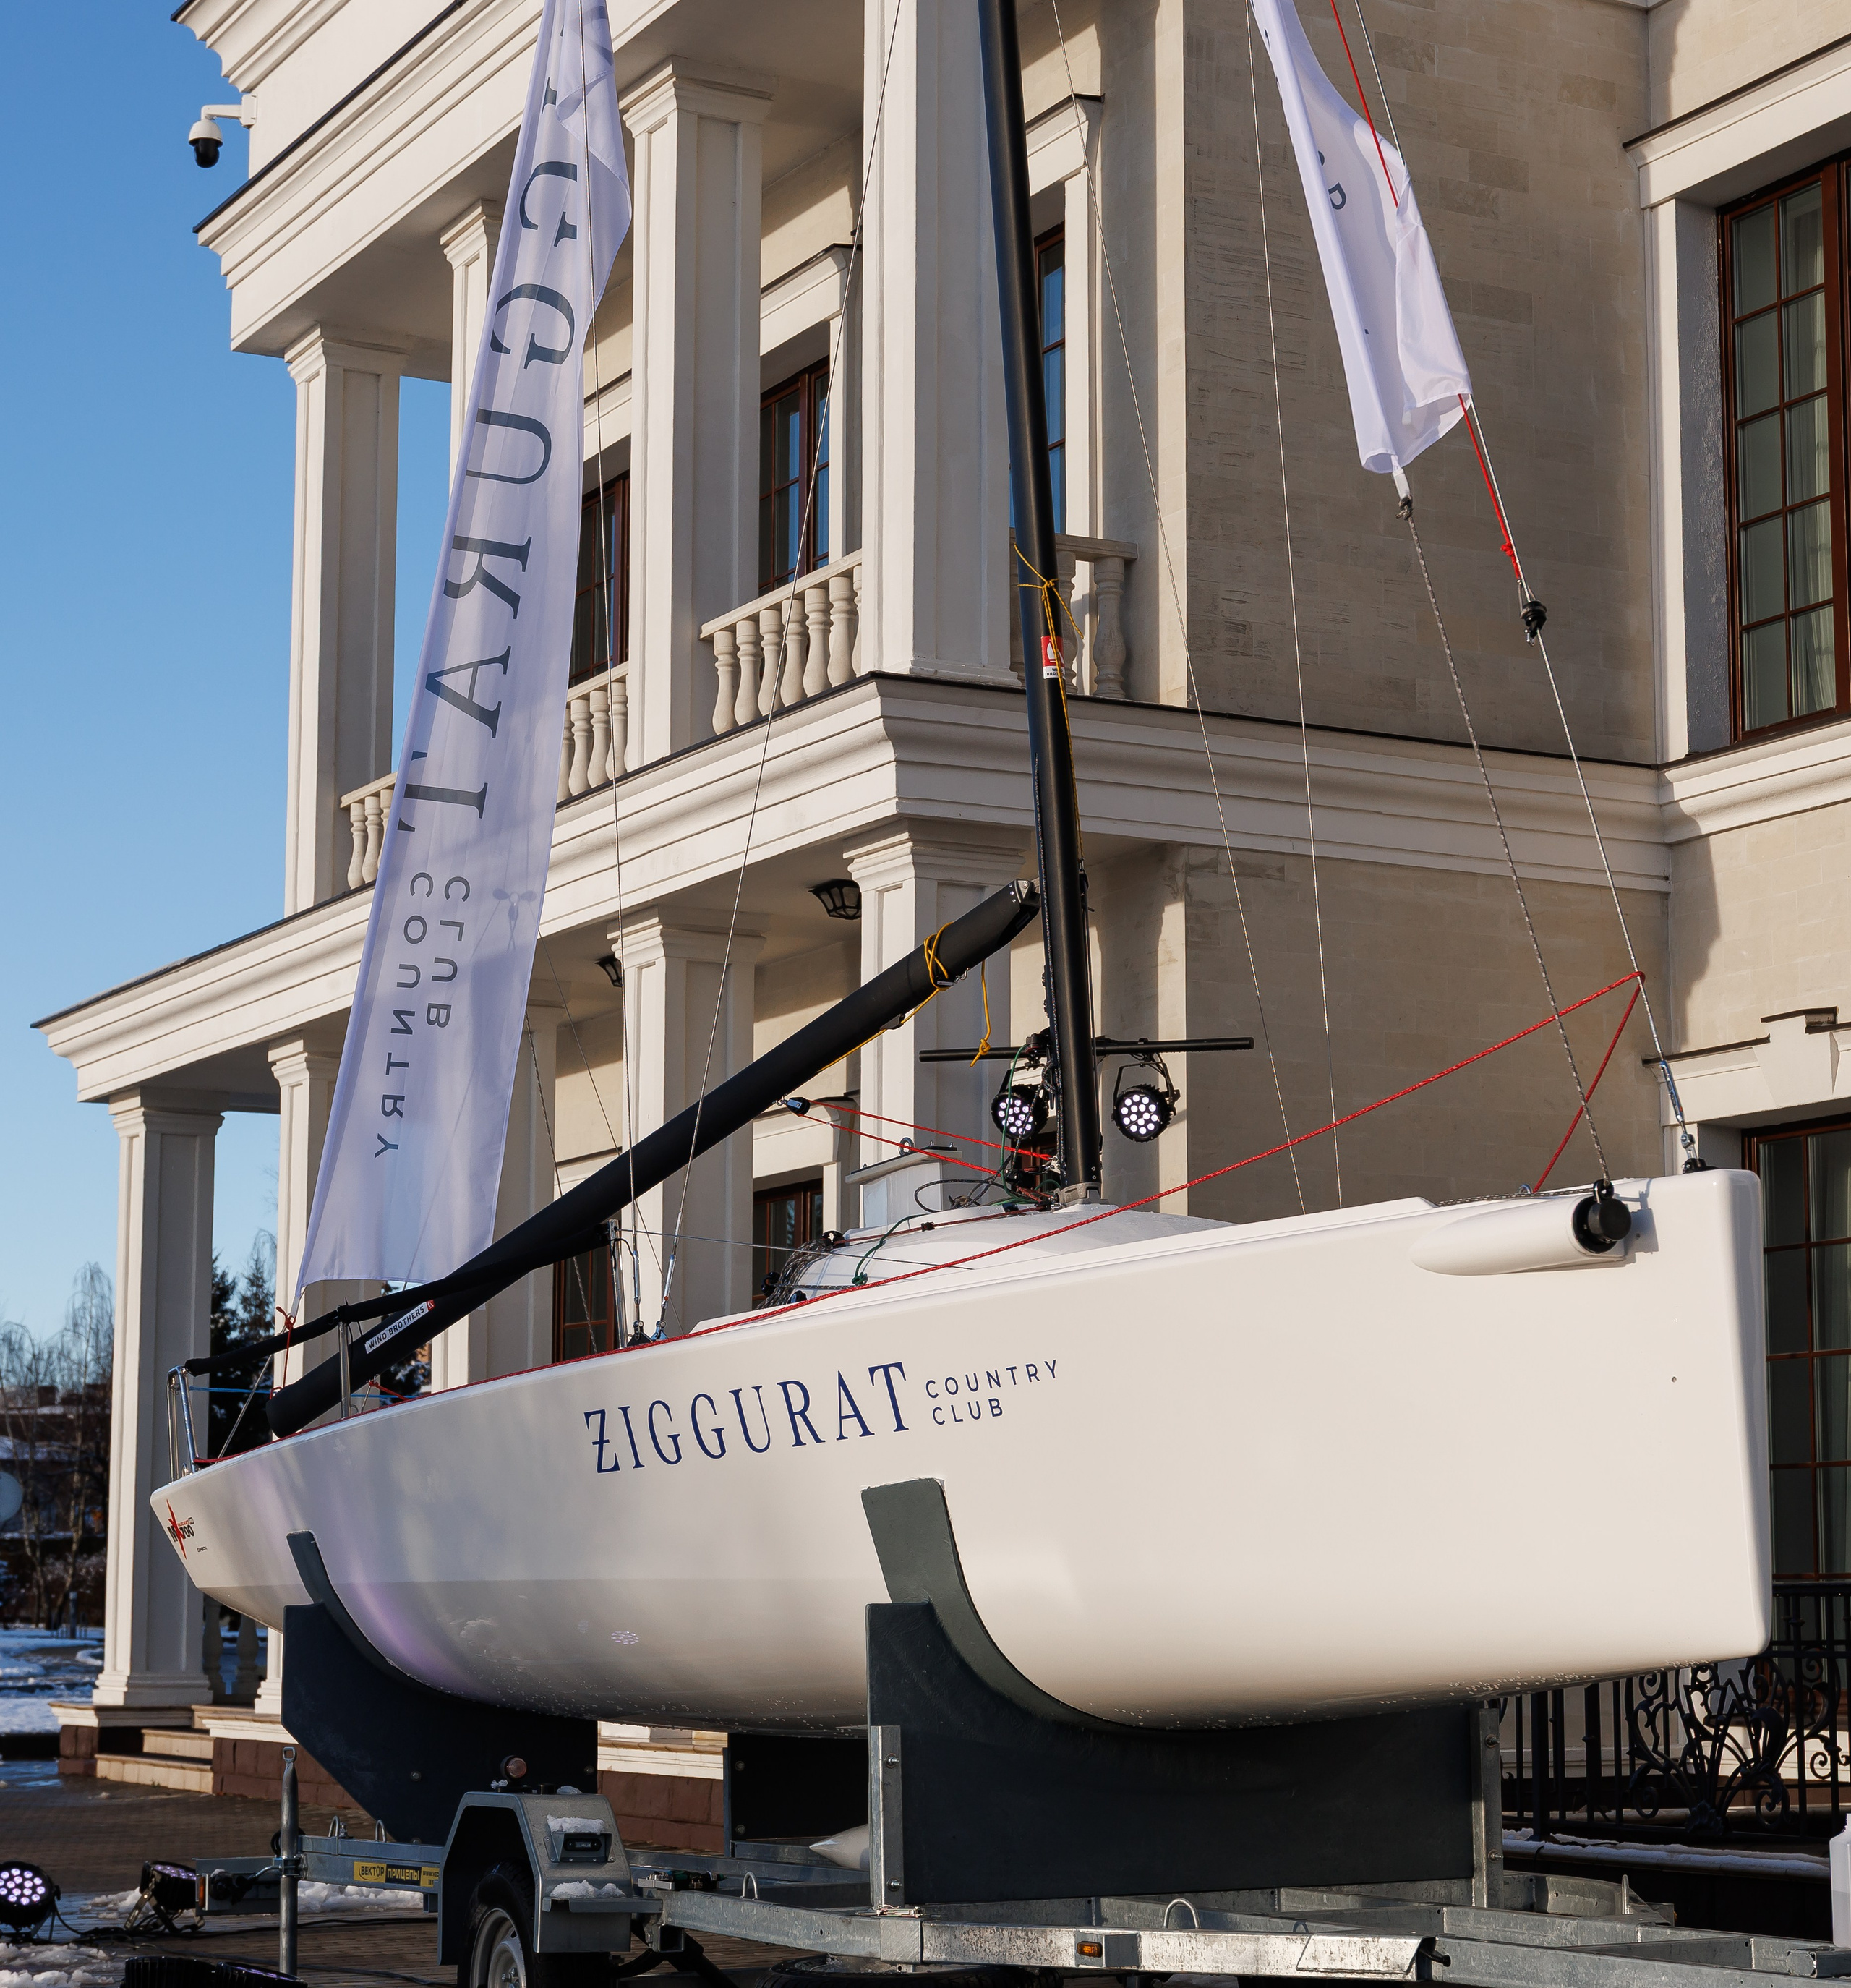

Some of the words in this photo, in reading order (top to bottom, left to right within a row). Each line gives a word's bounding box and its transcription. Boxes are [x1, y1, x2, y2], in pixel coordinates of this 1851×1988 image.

[367, 1332, 387, 1349] WIND
[388, 1305, 424, 1336] BROTHERS
[925, 1359, 1058, 1399] COUNTRY
[583, 1361, 910, 1474] ZIGGURAT
[931, 1396, 1004, 1426] CLUB
[361, 1866, 385, 1877] ВЕКТОР
[387, 1868, 419, 1880] ПРИЦЕПЫ
